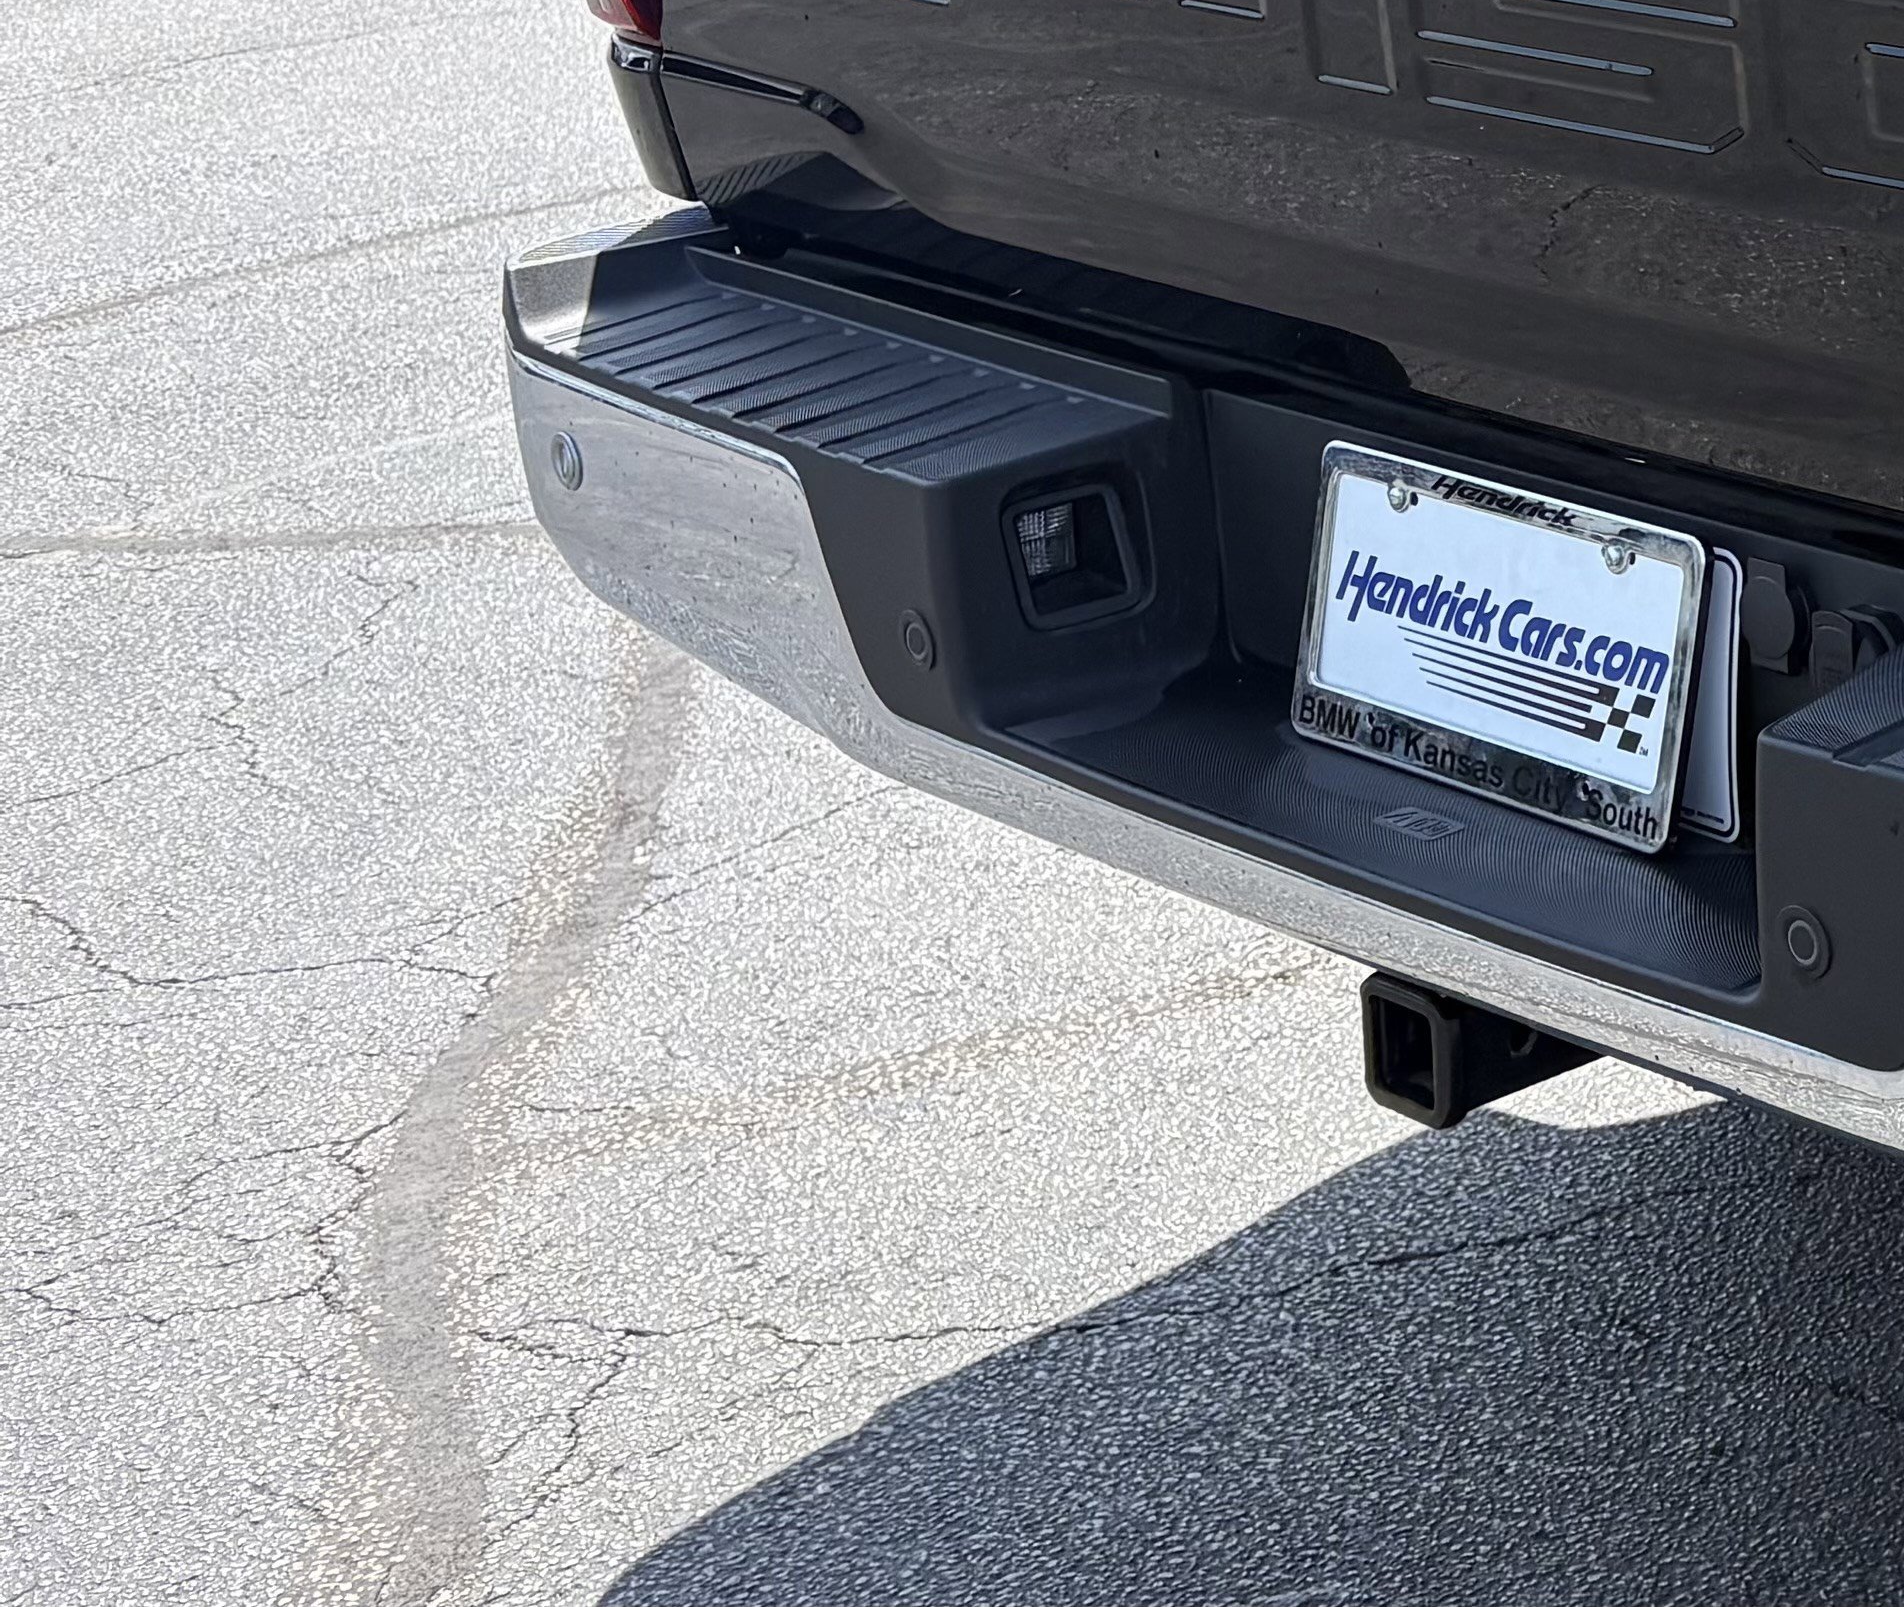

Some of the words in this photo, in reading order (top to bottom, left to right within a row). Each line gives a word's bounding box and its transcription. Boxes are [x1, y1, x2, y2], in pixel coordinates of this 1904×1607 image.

[1430, 474, 1577, 527] Hendrick
[1299, 696, 1359, 741] BMW
[1403, 731, 1505, 789] Kansas
[1512, 766, 1568, 816] City
[1584, 790, 1659, 841] South
